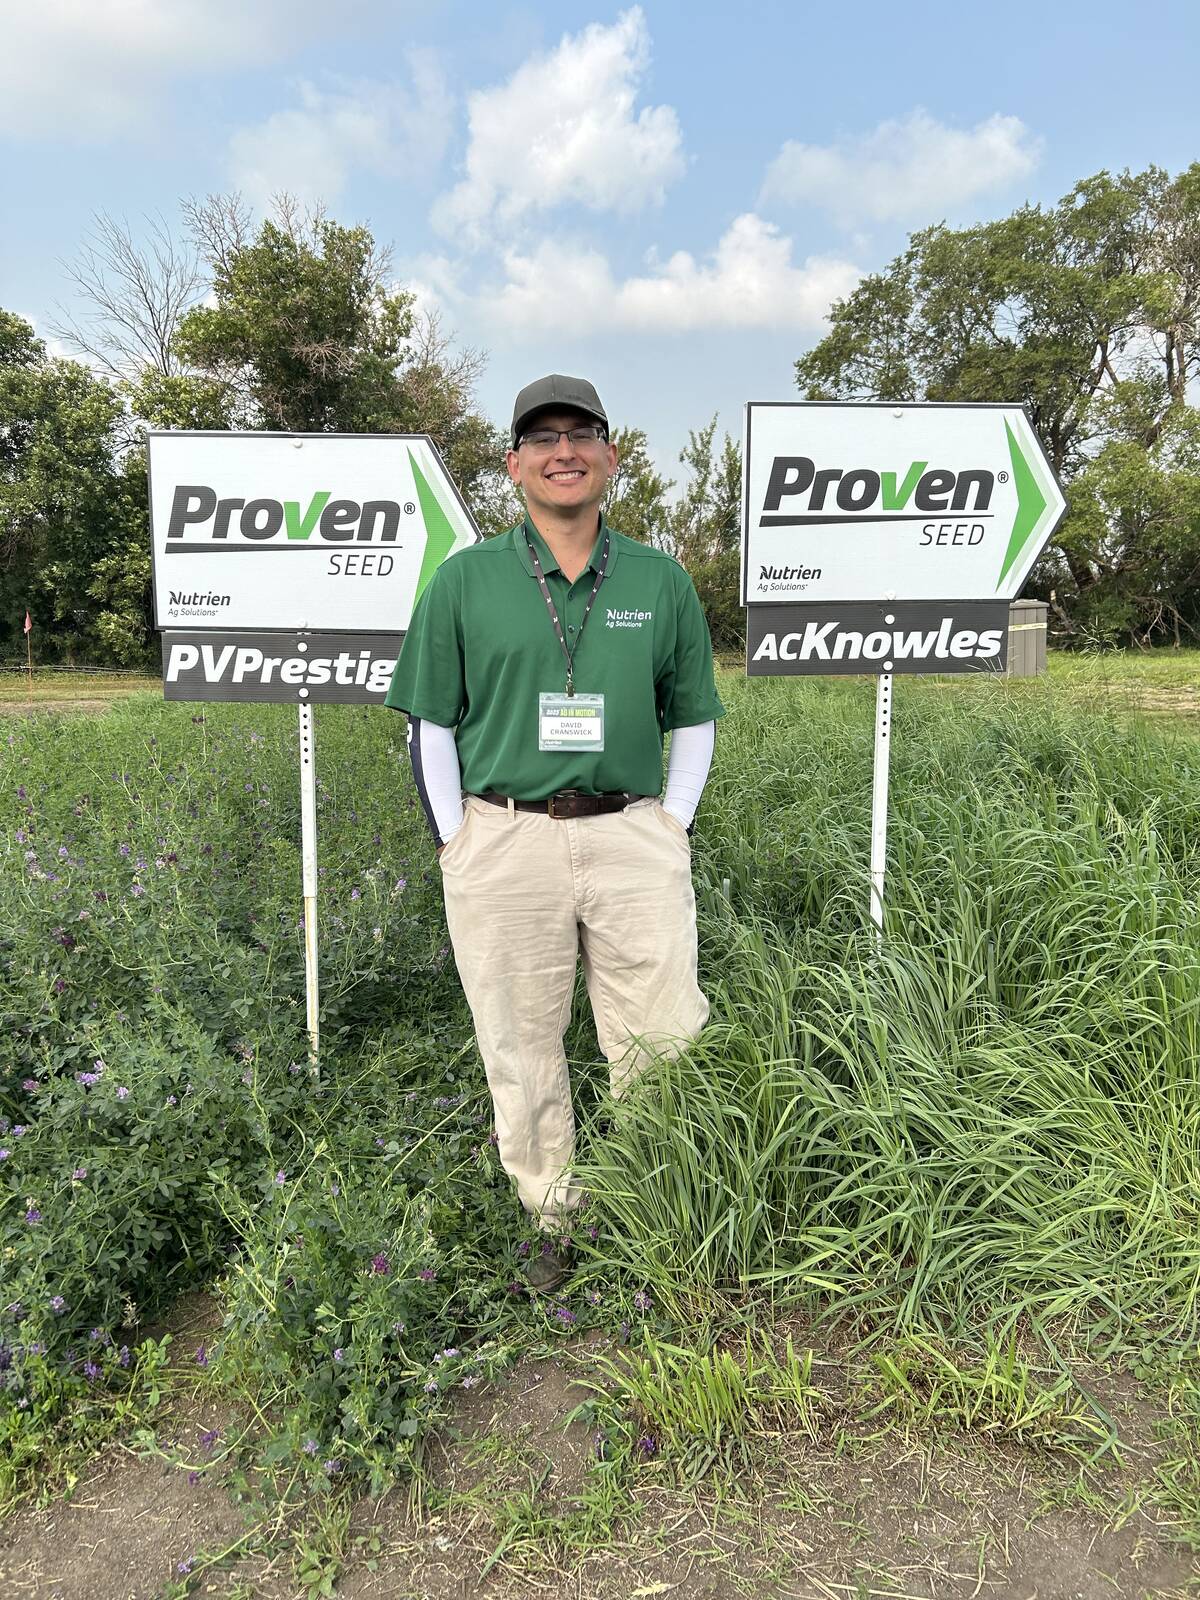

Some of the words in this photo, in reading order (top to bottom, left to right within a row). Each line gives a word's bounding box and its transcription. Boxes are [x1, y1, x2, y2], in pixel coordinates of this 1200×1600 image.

[919, 524, 985, 546] SEED
[327, 554, 394, 577] SEED
[759, 564, 822, 580] Nutrien
[757, 583, 769, 593] Ag
[168, 591, 231, 606] Nutrien
[168, 608, 179, 618] Ag
[606, 608, 652, 620] Nutrien
[605, 620, 615, 629] Ag
[615, 620, 642, 628] Solutions
[166, 644, 398, 692] PVPrestig
